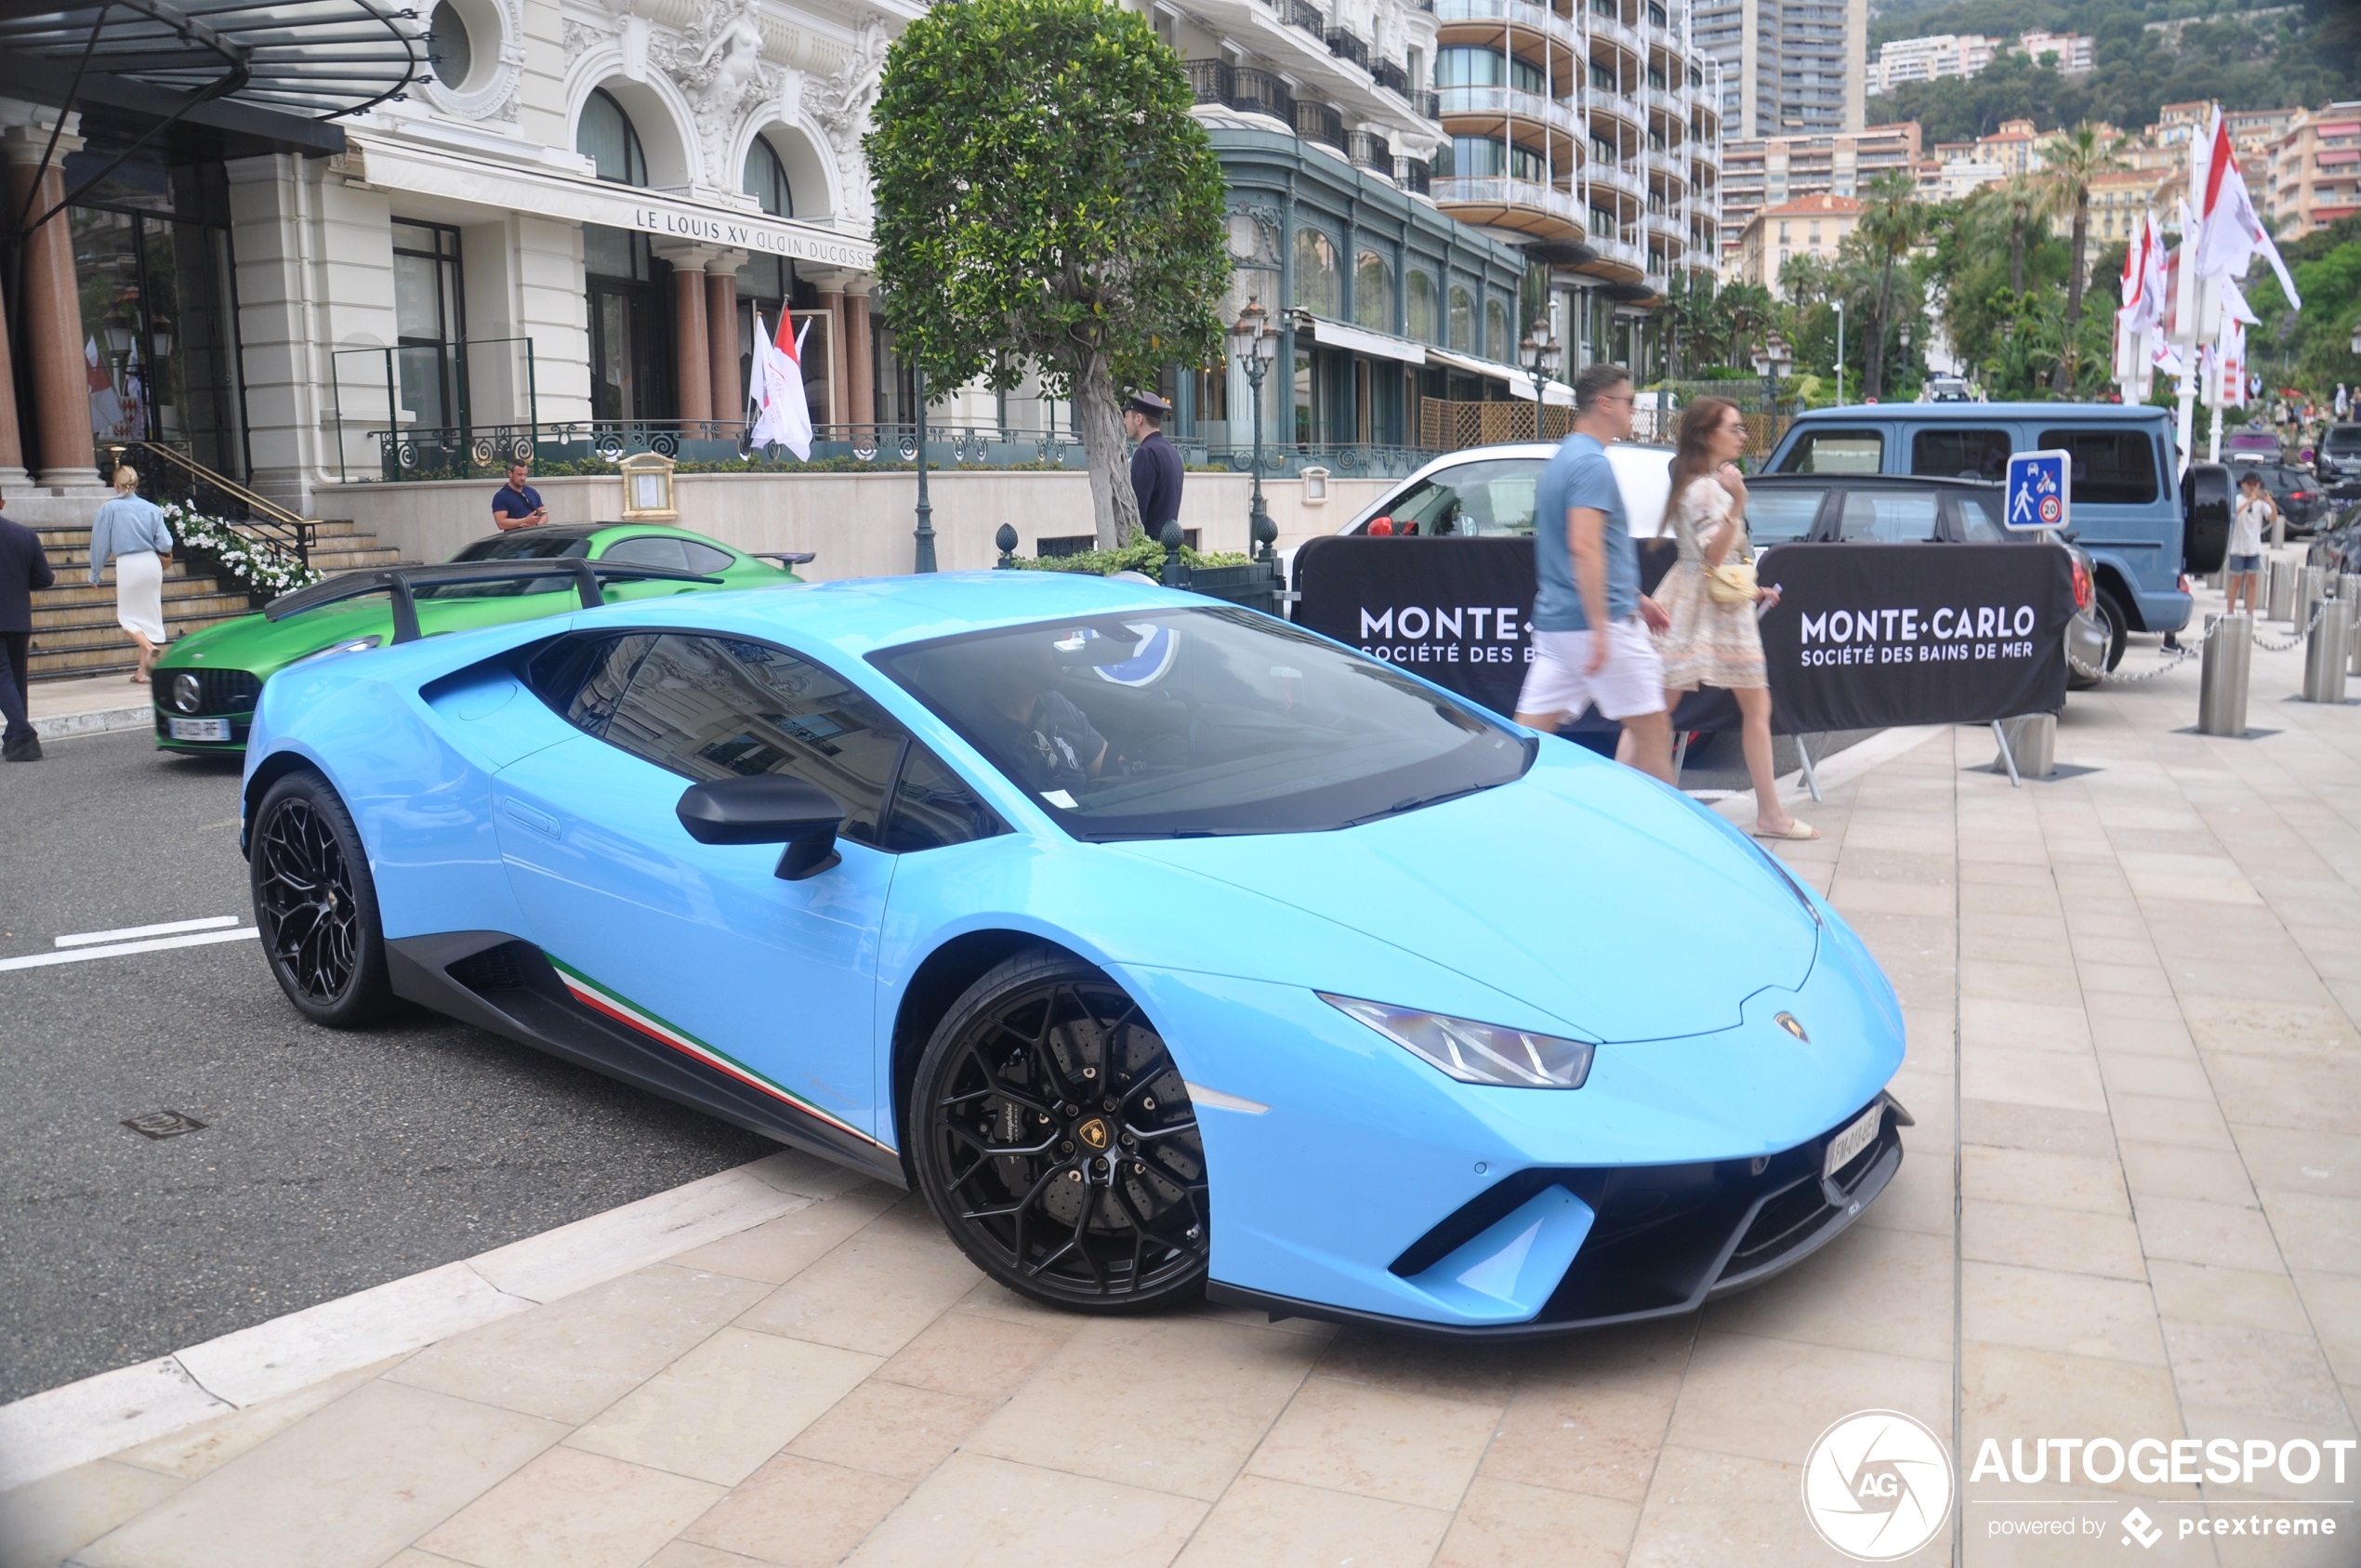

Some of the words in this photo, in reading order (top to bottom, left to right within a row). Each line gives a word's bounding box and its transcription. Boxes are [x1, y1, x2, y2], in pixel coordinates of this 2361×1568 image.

[637, 209, 657, 229] LE
[667, 215, 719, 239] LOUIS
[728, 226, 748, 244] XV
[2044, 504, 2056, 514] 20
[1471, 647, 1513, 663] DES
[1801, 644, 1875, 666] SOCIÉTÉ
[1881, 646, 1913, 664] DES
[1919, 644, 1969, 662] BAINS
[1974, 643, 1997, 659] DE
[2002, 641, 2033, 658] MER
